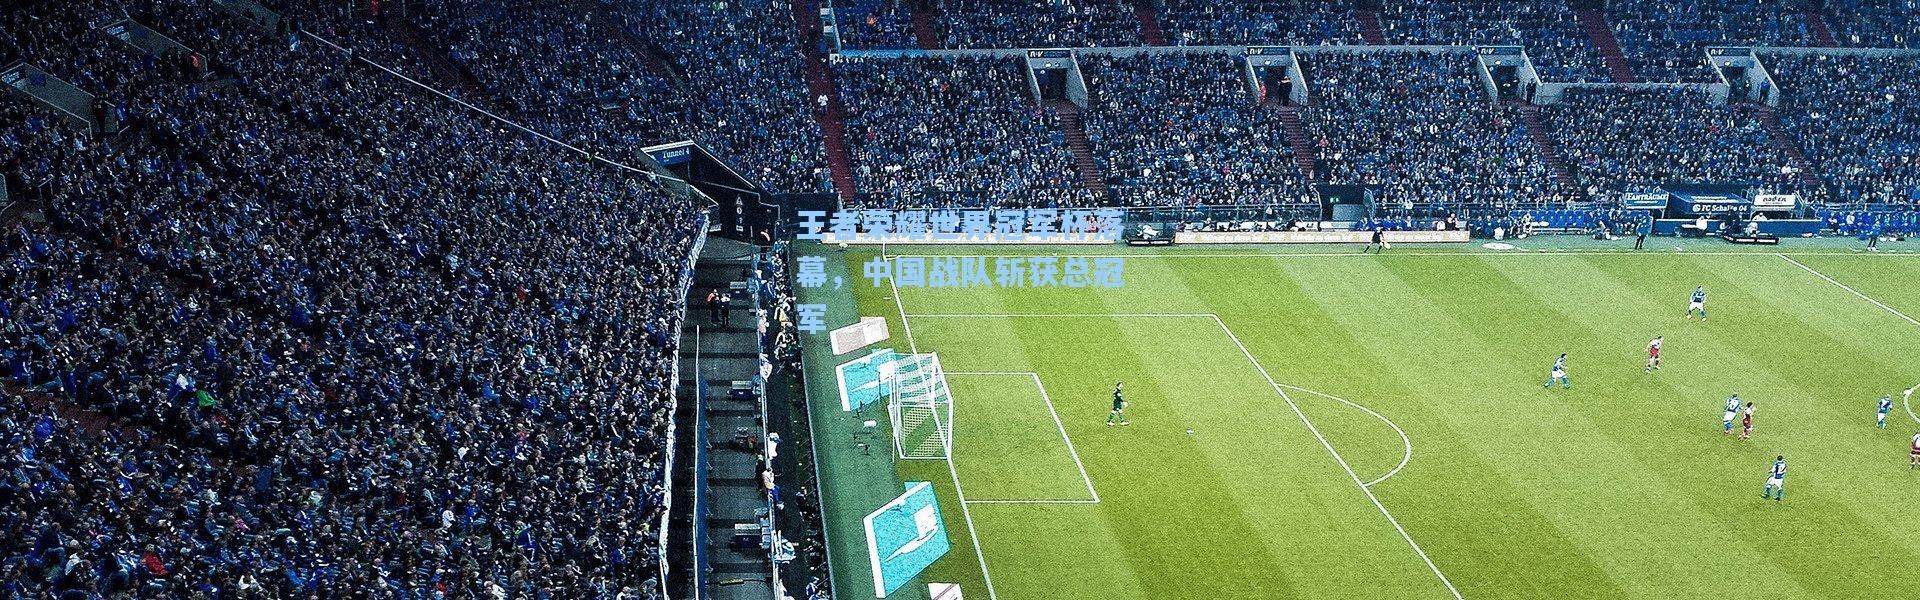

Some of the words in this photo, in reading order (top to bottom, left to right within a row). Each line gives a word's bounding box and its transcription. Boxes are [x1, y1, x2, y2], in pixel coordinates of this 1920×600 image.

[663, 149, 685, 159] Tunnel
[1701, 204, 1711, 212] FC
[1738, 204, 1748, 212] 04
